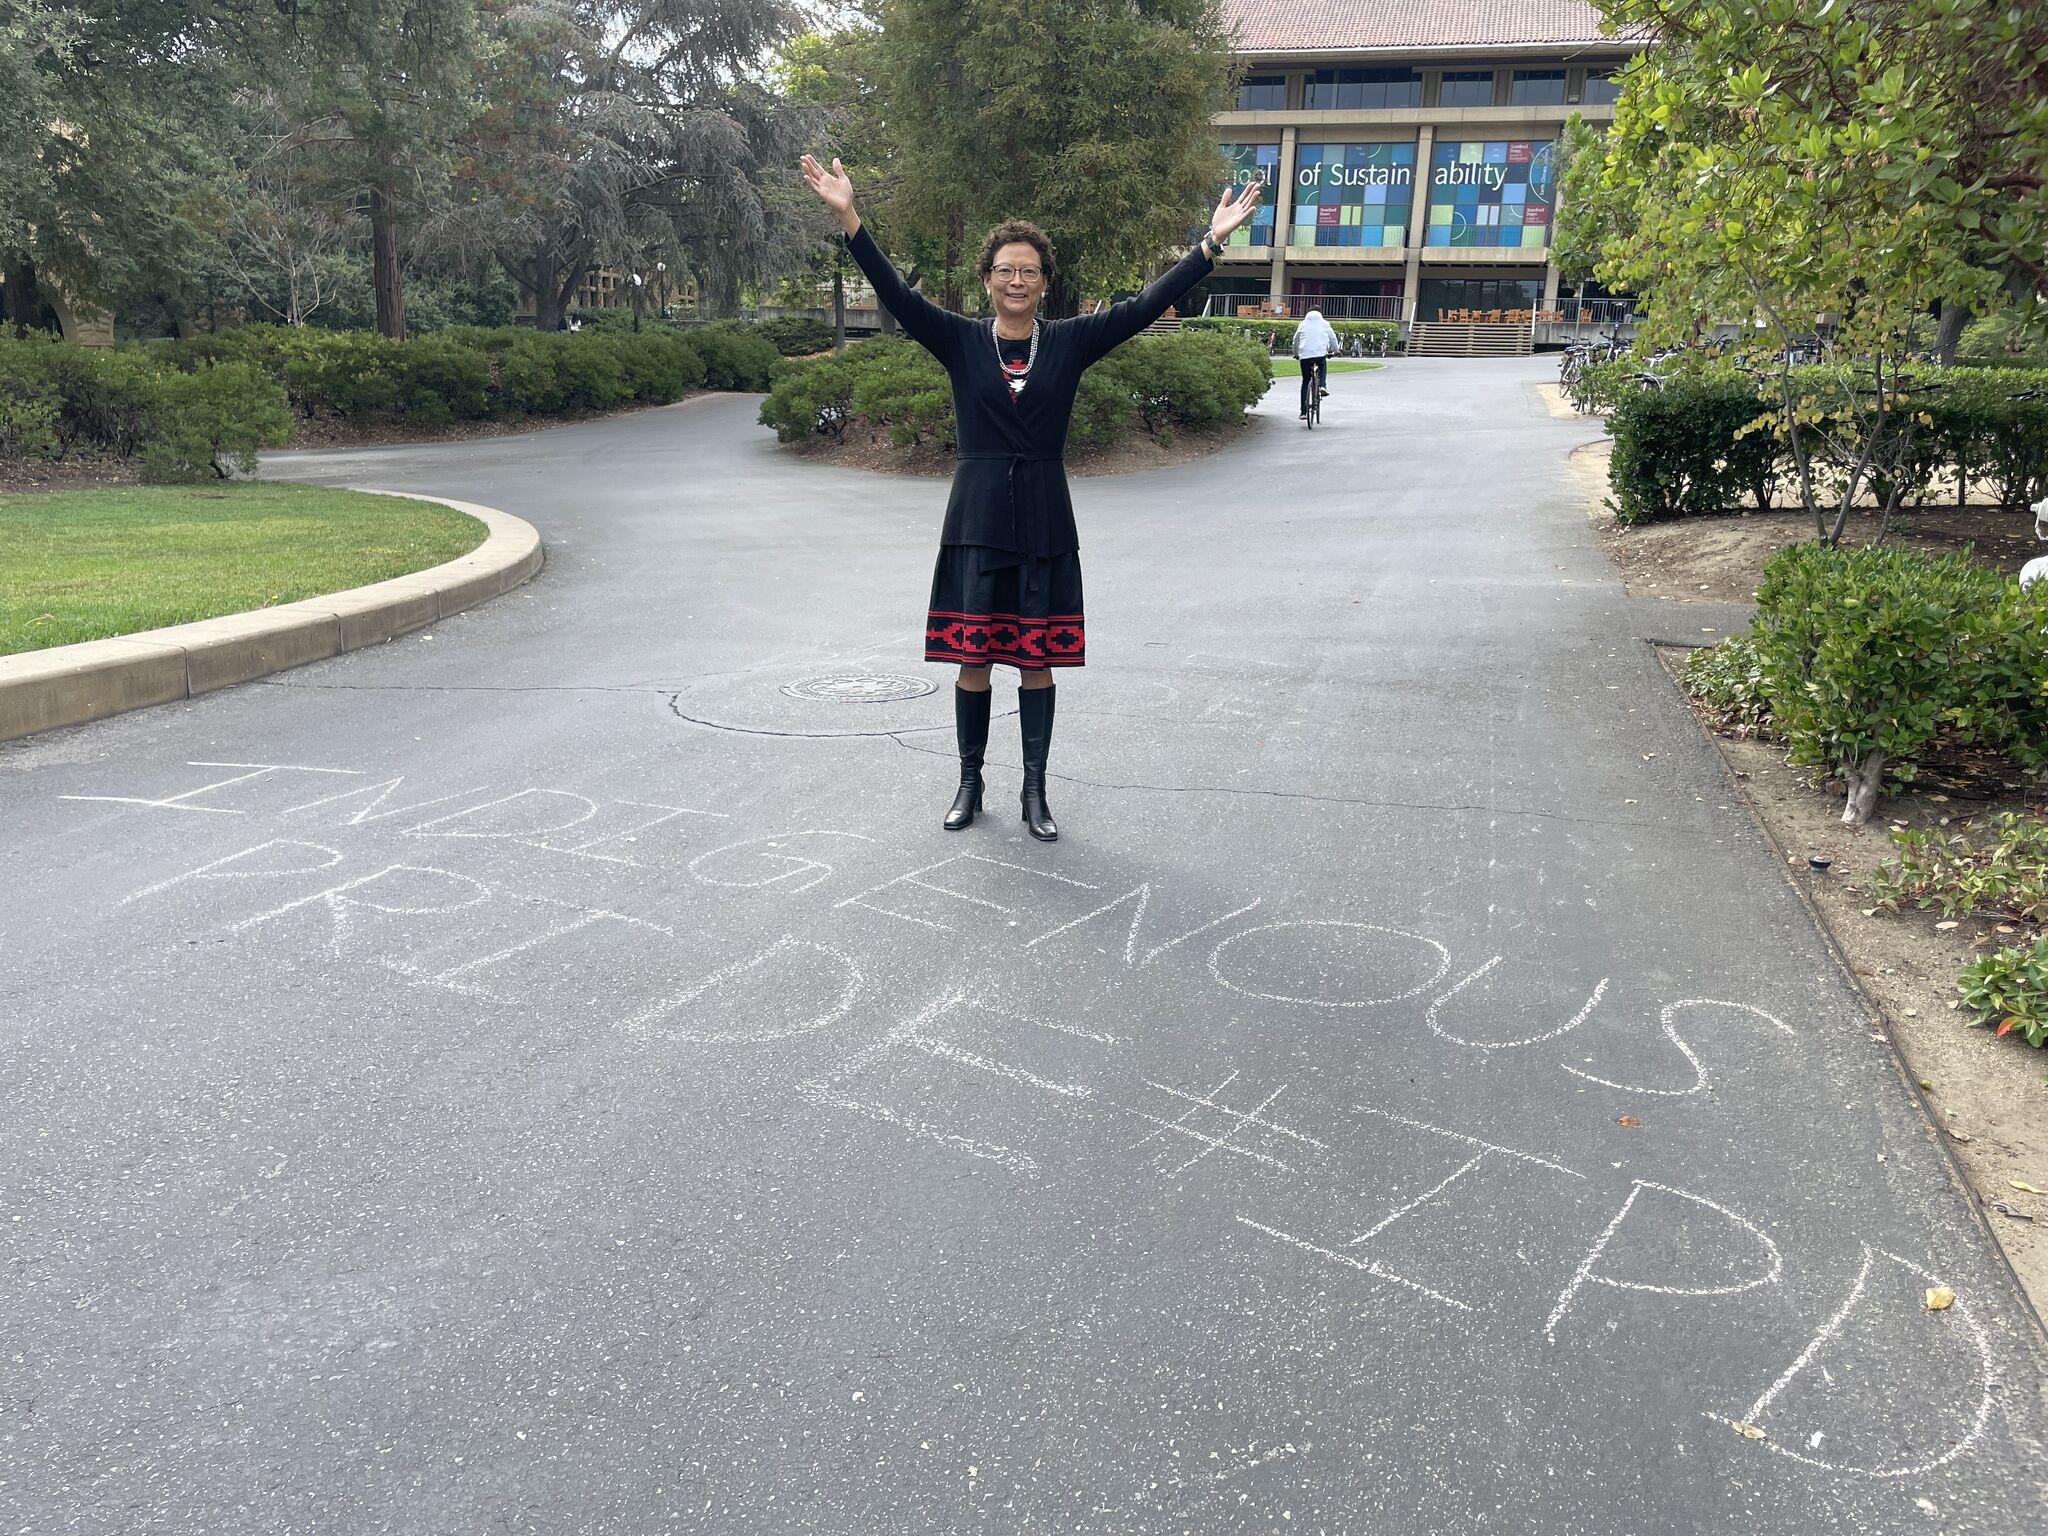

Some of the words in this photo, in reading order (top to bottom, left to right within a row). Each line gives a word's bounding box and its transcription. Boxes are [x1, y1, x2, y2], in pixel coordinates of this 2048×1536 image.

[1299, 162, 1321, 186] of
[1329, 162, 1410, 186] Sustain
[1435, 160, 1508, 191] ability
[60, 761, 1796, 1096] INDIGENOUS
[120, 838, 1117, 1178] PRIDE
